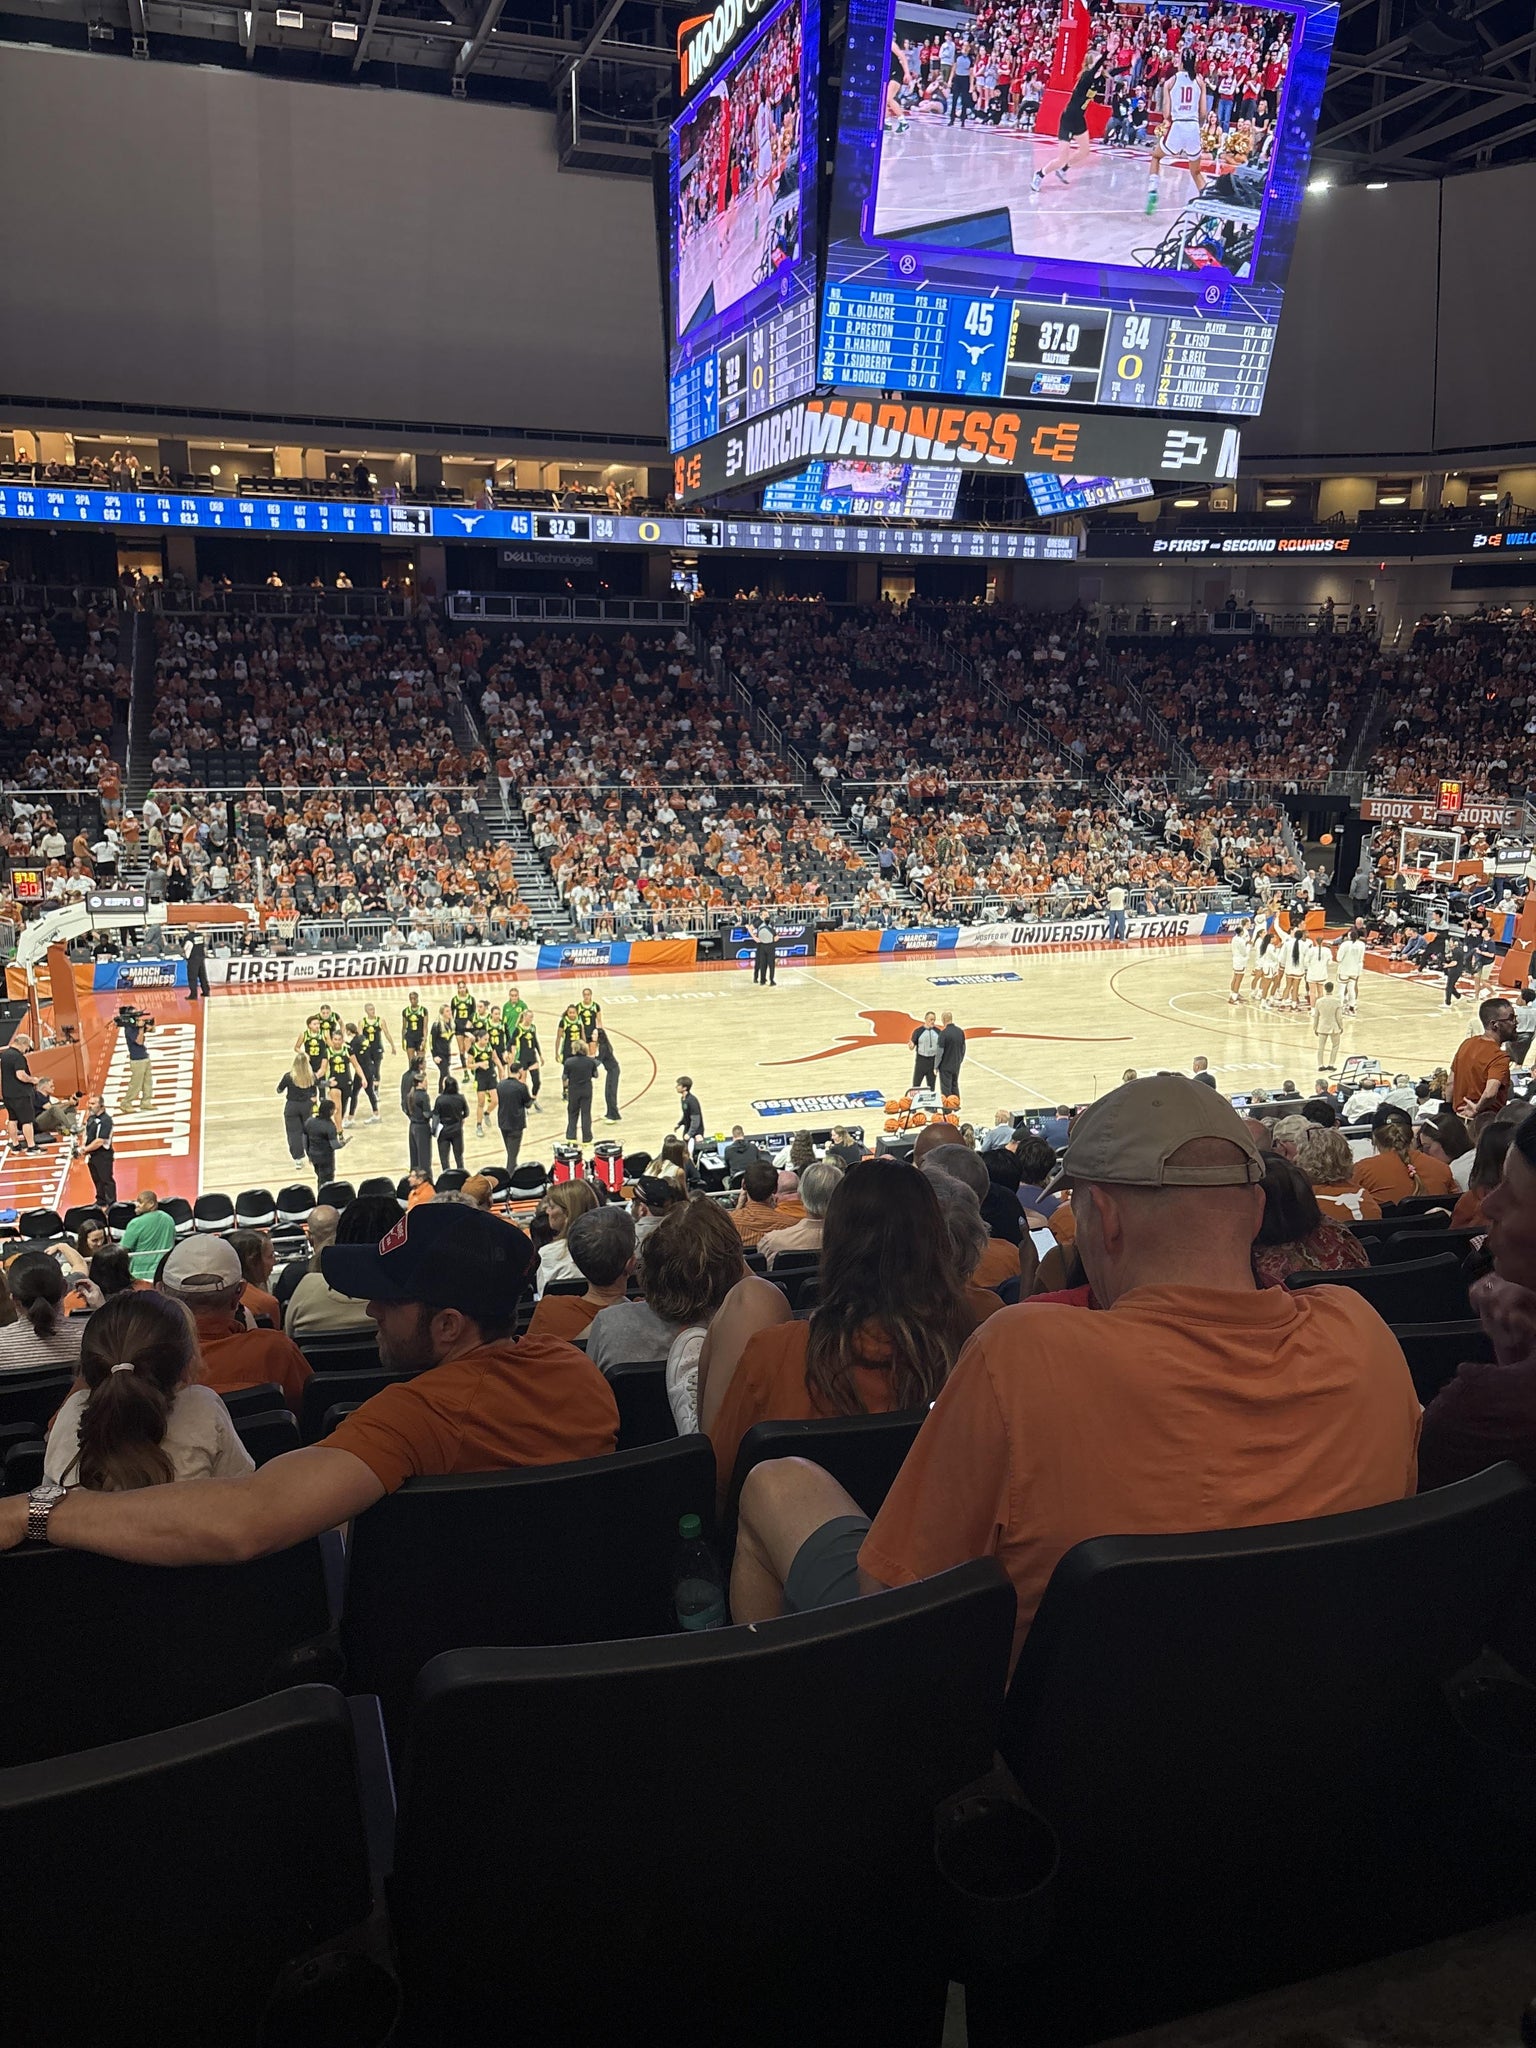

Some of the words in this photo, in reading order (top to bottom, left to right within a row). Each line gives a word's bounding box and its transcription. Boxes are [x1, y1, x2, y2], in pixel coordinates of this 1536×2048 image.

[1181, 87, 1192, 103] 10
[870, 291, 894, 304] PLAYER
[916, 297, 927, 307] PTS
[936, 298, 947, 308] FLS
[829, 302, 839, 315] 00
[848, 303, 895, 320] K.OLDACRE
[964, 302, 994, 336] 45
[847, 320, 893, 337] B.PRESTON
[1038, 321, 1079, 352] 37.9
[1122, 316, 1151, 350] 34
[1205, 322, 1227, 334] PLAYER
[1244, 327, 1255, 335] PTS
[1261, 327, 1272, 337] FLS
[828, 336, 834, 348] 3
[845, 337, 891, 353] R.HARMON
[1170, 333, 1177, 345] 2
[1184, 334, 1210, 347] K.FISO
[824, 352, 835, 365] 32
[844, 353, 893, 369] T.SIDBERRY
[1167, 350, 1173, 361] 3
[1182, 350, 1206, 363] S.BELL
[1117, 355, 1143, 380] O
[1179, 365, 1206, 378] A.LONG
[822, 368, 834, 380] 35
[842, 369, 886, 384] M.BOOKER
[1160, 379, 1170, 390] 22
[1176, 381, 1219, 394] J.WILLIAMS
[1157, 394, 1168, 405] 35
[1173, 396, 1203, 408] E.ETUTE
[746, 402, 805, 476] MARCH
[802, 400, 1022, 465] MADNESS
[18, 492, 34, 502] FG%
[48, 493, 64, 504] 3PM
[75, 495, 90, 505] 3PA
[136, 498, 145, 508] FT
[158, 499, 170, 509] FTA
[182, 500, 196, 510] FT%
[343, 508, 355, 518] BLK
[370, 509, 382, 519] STL
[820, 499, 833, 511] 45
[18, 505, 34, 516] 51.4
[53, 507, 59, 518] 4
[139, 511, 146, 521] 5
[215, 514, 221, 525] 4
[270, 517, 279, 528] 15
[322, 519, 328, 530] 3
[418, 511, 425, 521] 3
[511, 516, 528, 533] 45
[549, 519, 576, 535] 37.9
[596, 519, 613, 537] 34
[639, 521, 660, 541] O
[730, 536, 735, 546] 3
[794, 539, 800, 548] 4
[880, 542, 885, 552] 3
[897, 543, 901, 553] 4
[934, 544, 939, 554] 3
[1168, 539, 1209, 551] FIRST
[1223, 539, 1276, 551] SECOND
[1278, 539, 1335, 551] ROUNDS
[504, 551, 533, 561] DELL
[533, 552, 593, 567] Technologies
[1370, 803, 1413, 818] HOOK
[1419, 806, 1438, 820] 'E
[905, 934, 926, 942] MARCH
[1011, 923, 1110, 943] UNIVERSITY
[1141, 920, 1189, 938] TEXAS
[907, 940, 937, 948] MADNESS
[572, 948, 598, 957] MARCH
[575, 955, 609, 965] MADNESS
[129, 967, 160, 976] MARCH
[225, 960, 294, 984] FIRST
[293, 966, 314, 976] AND
[317, 955, 409, 979] SECOND
[418, 951, 518, 974] ROUNDS
[134, 975, 174, 986] MADNESS
